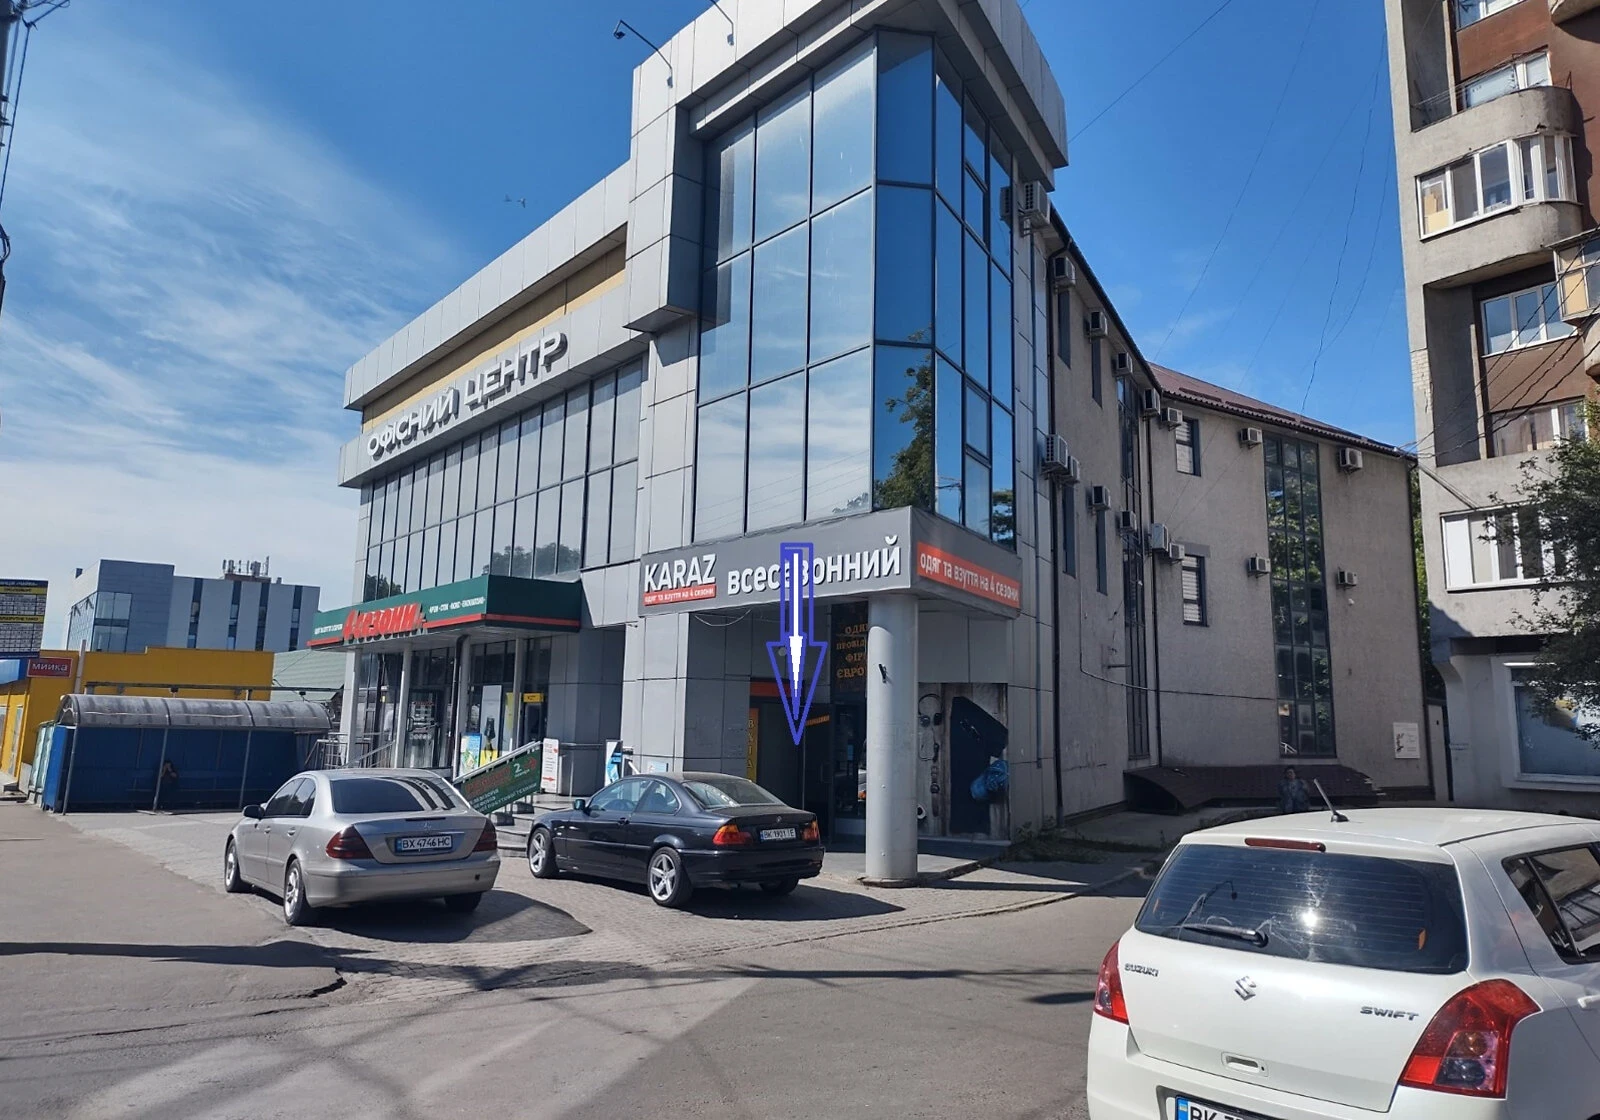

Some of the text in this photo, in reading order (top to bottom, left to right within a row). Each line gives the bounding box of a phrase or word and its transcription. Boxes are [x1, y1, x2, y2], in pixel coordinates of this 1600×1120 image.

[367, 332, 567, 458] ОФІСНИЙ ЦЕНТР
[644, 553, 716, 592] KARAZ
[920, 553, 1019, 601] одяг та взуття на 4 сезони
[513, 763, 522, 773] 2
[402, 837, 450, 849] BX 4746 HC
[1124, 963, 1159, 977] SUZUKI
[1360, 1006, 1419, 1021] SWIFT
